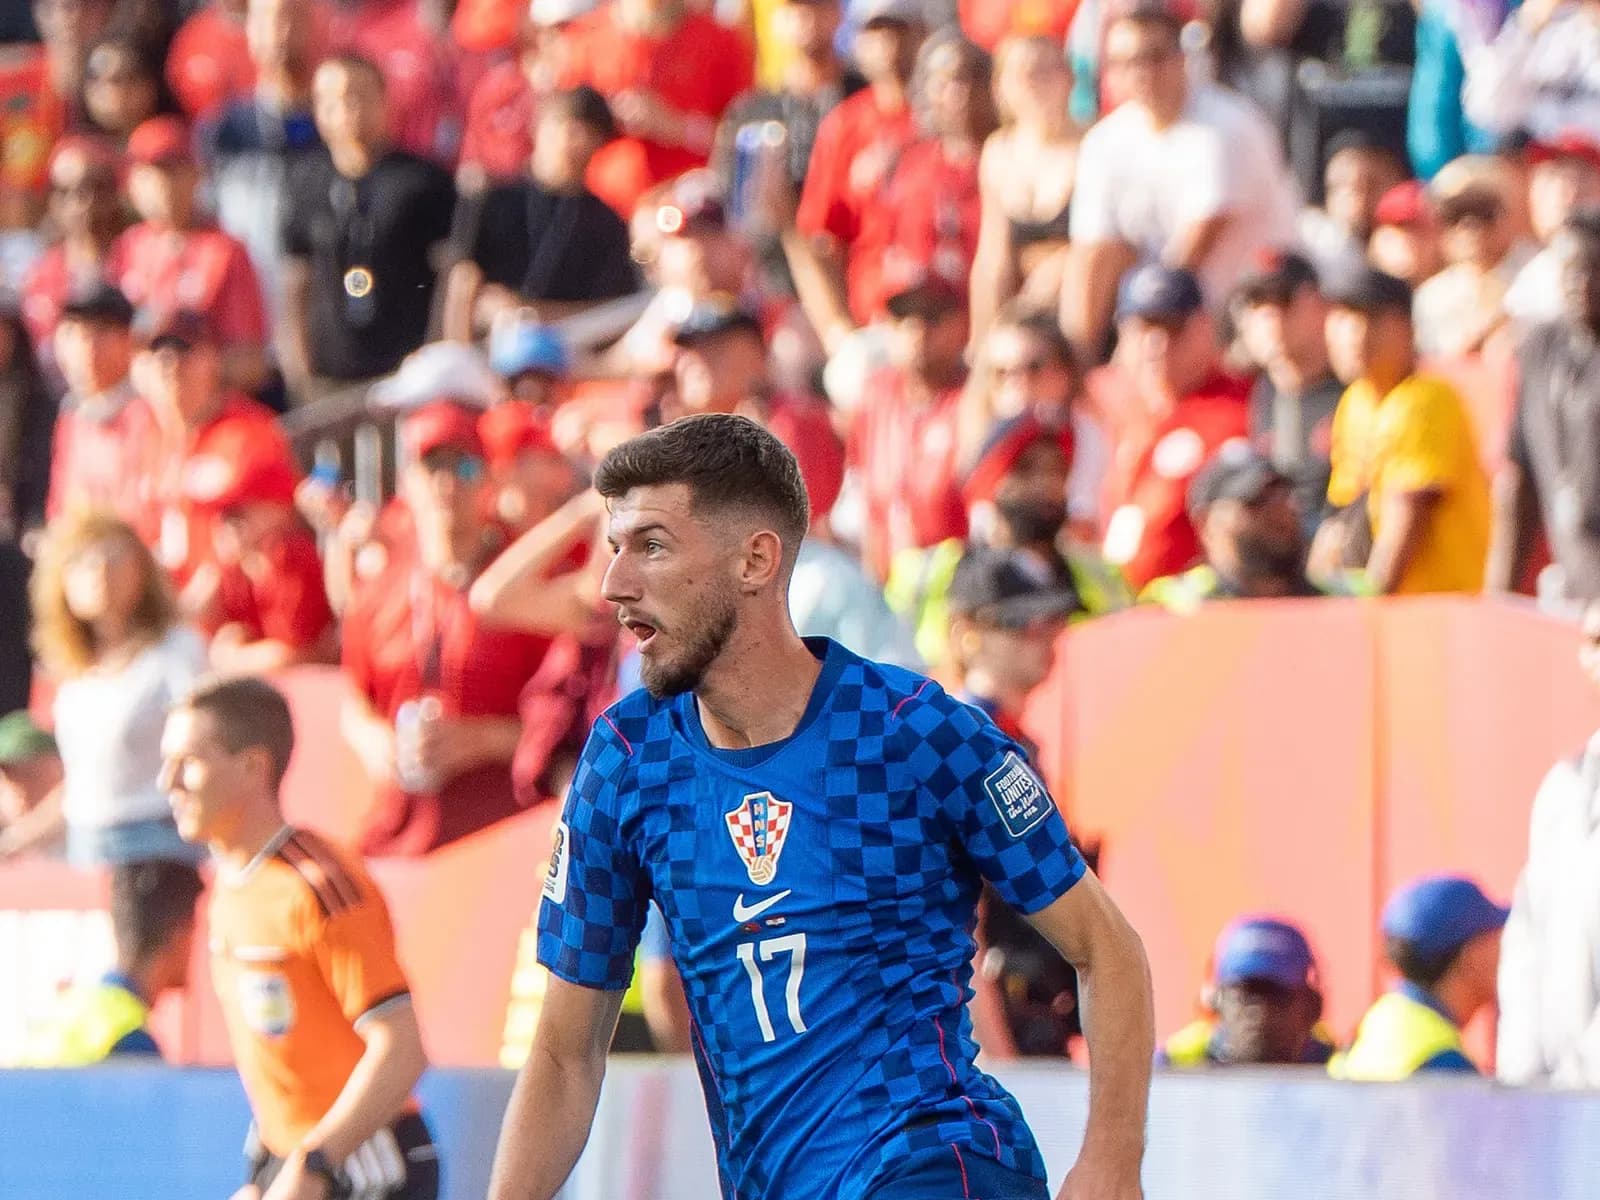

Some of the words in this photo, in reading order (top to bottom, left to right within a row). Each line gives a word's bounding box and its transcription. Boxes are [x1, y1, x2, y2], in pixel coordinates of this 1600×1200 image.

[1001, 773, 1033, 805] UNITES
[753, 803, 765, 848] HNS
[736, 932, 808, 1042] 17
